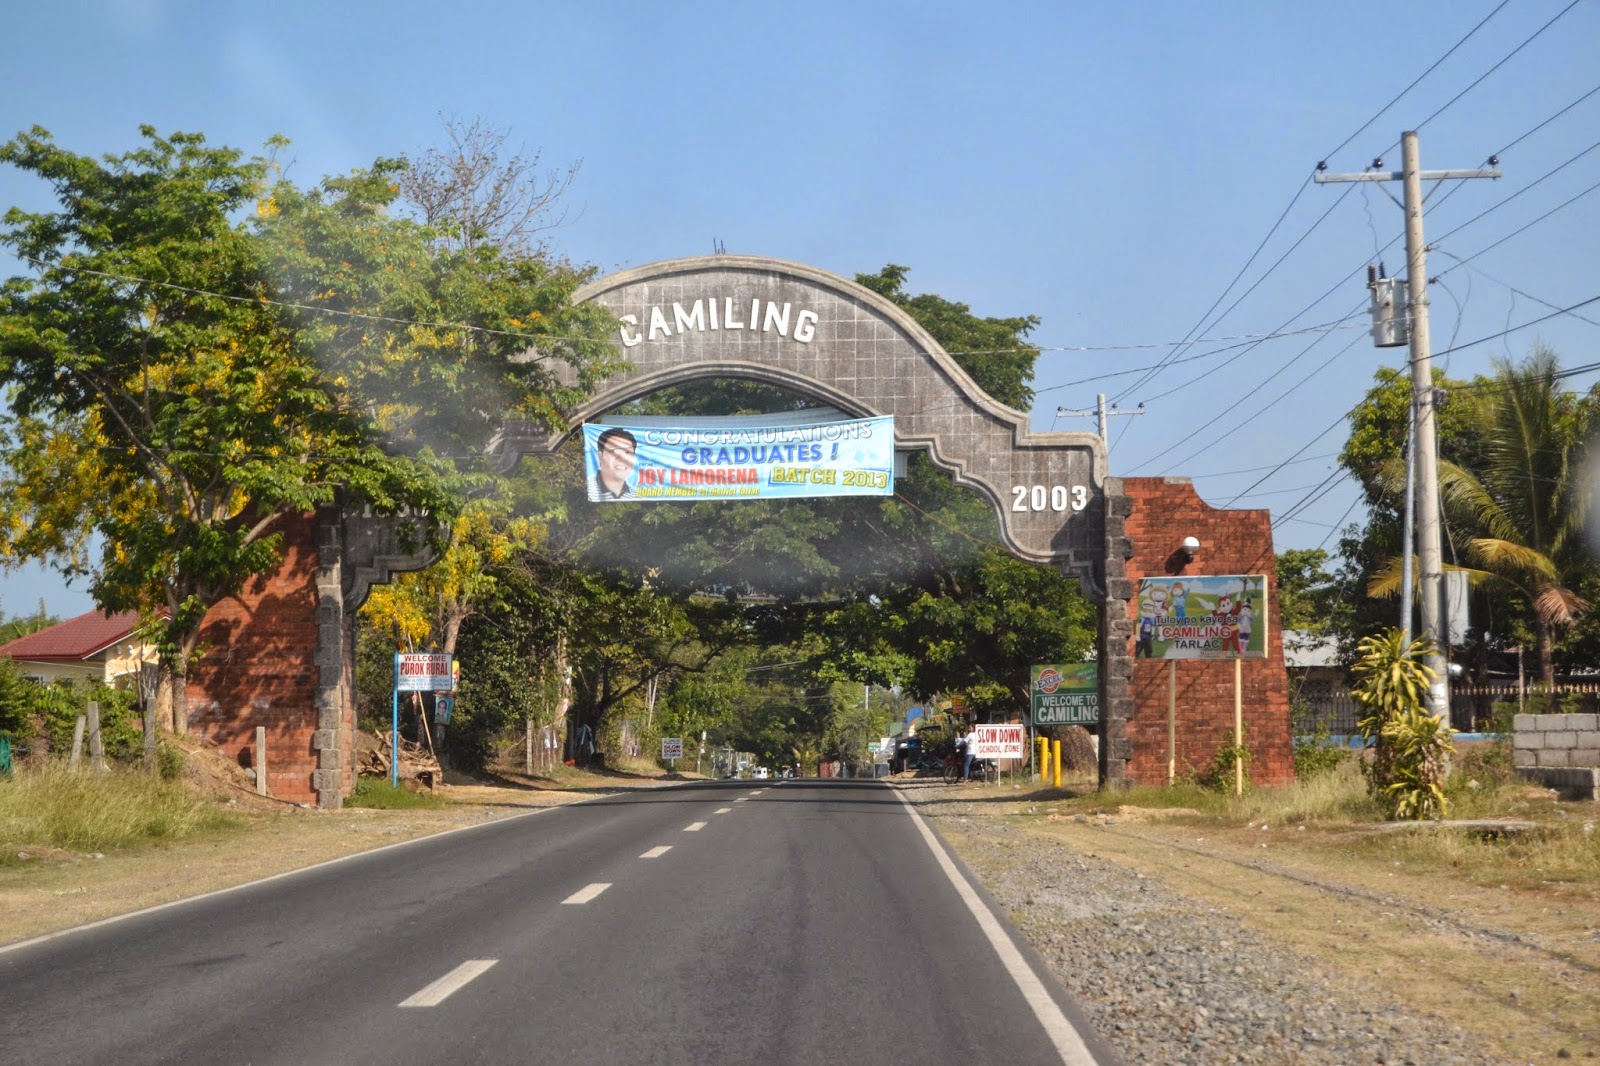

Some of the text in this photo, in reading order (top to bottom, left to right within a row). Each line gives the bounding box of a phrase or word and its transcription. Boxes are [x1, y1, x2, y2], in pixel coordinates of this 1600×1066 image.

[619, 297, 819, 347] CAMILING
[644, 420, 873, 446] CONGRATULATIONS
[681, 443, 823, 465] GRADUATES
[637, 467, 759, 486] JOY LAMORENA
[772, 467, 889, 489] BATCH 2013
[636, 487, 663, 497] BOARD
[664, 487, 697, 497] MEMBER
[1011, 485, 1087, 512] 2003
[1155, 615, 1238, 626] Tuloy po kayo sa
[1162, 626, 1232, 638] CAMILING
[1175, 639, 1219, 649] TARLAC
[400, 662, 448, 675] PUROK RURAL
[1042, 695, 1097, 706] WELCOME TO
[1038, 706, 1099, 722] CAMILING
[977, 729, 1020, 743] SLOW DOWN
[979, 745, 1001, 753] SCHOOL
